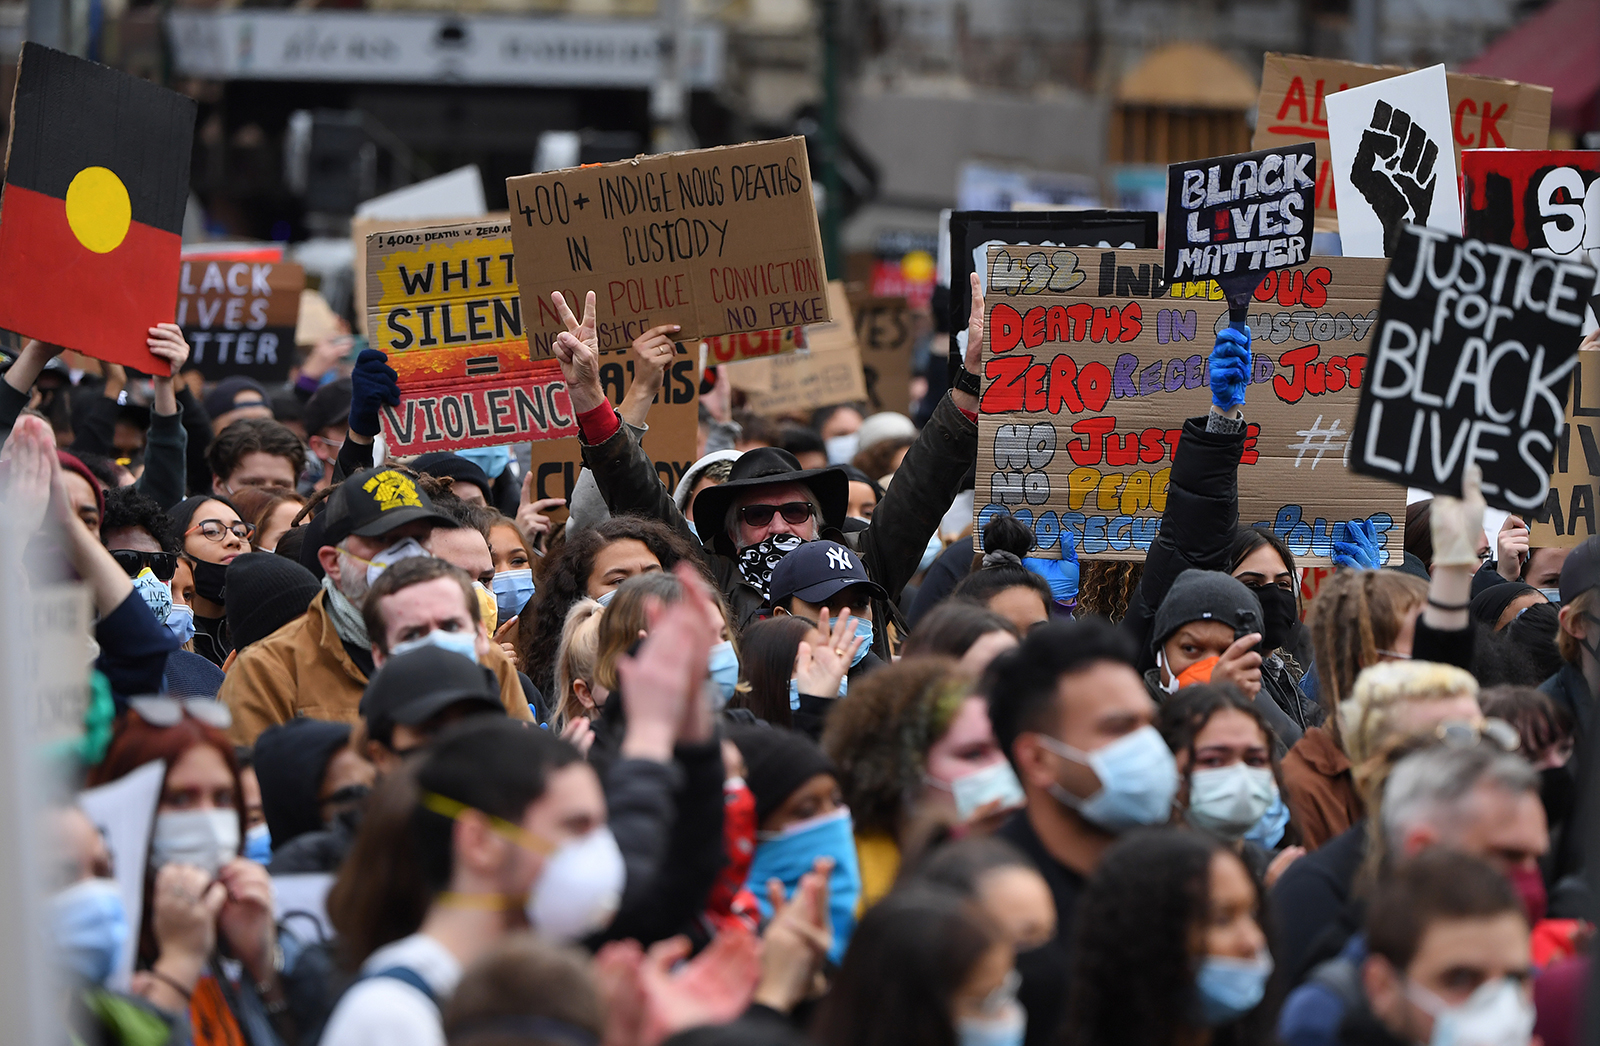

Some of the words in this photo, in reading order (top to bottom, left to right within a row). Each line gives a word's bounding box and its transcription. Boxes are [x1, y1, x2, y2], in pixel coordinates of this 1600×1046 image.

[1277, 76, 1349, 127] AL
[516, 181, 590, 226] 400+
[731, 156, 802, 202] DEATHS
[1181, 154, 1315, 210] BLACK
[387, 235, 423, 248] 400+
[424, 230, 460, 242] DEATHS
[476, 226, 500, 237] ZERO
[566, 235, 593, 272] IN
[623, 217, 728, 266] CUSTODY
[1173, 236, 1306, 279] MATTER
[398, 254, 515, 296] WHIT
[609, 274, 689, 316] POLICE
[710, 258, 820, 304] CONVICTION
[991, 250, 1087, 296] 432
[1386, 223, 1597, 327] JUSTICE
[387, 296, 522, 350] SILEN
[727, 306, 758, 331] NO
[769, 297, 824, 325] PEACE
[989, 301, 1143, 354] DEATHS
[1157, 308, 1198, 345] IN
[188, 331, 279, 364] TTER
[980, 353, 1112, 414] ZERO
[1370, 319, 1580, 438] BLACK
[383, 382, 571, 444] VIOLENC
[993, 422, 1058, 471] NO
[1363, 401, 1554, 509] LIVES
[990, 470, 1050, 506] NO
[825, 546, 853, 570] NY
